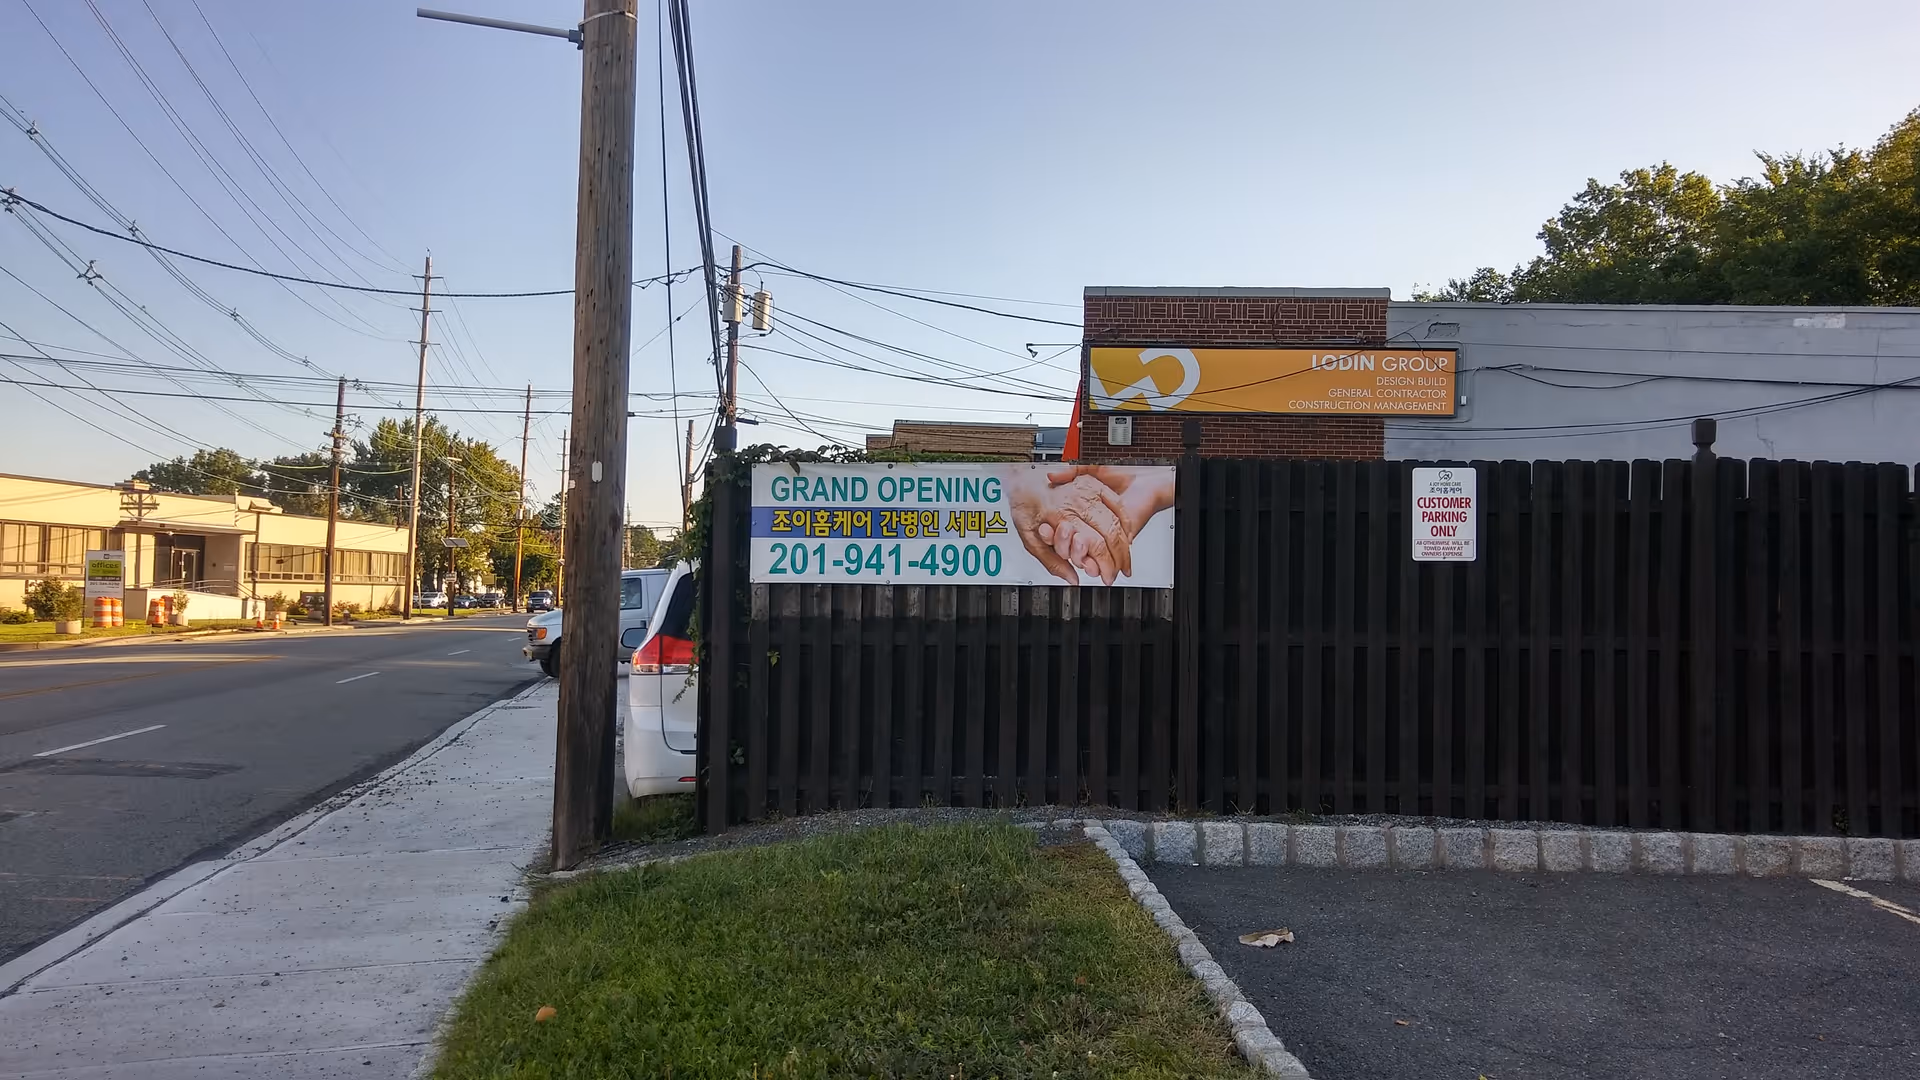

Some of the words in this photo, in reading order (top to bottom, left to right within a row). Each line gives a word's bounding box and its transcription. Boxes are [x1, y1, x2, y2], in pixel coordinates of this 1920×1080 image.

[1311, 354, 1375, 371] LODIN
[1381, 356, 1448, 373] GROUP
[1376, 376, 1415, 386] DESIGN
[1417, 376, 1447, 387] BUILD
[1328, 388, 1373, 398] GENERAL
[1376, 389, 1448, 399] CONTRACTOR
[1288, 400, 1371, 410] CONSTRUCTION
[1373, 401, 1447, 411] MANAGEMENT
[771, 476, 869, 502] GRAND
[877, 476, 1002, 503] OPENING
[1417, 497, 1471, 509] CUSTOMER
[1422, 511, 1467, 523] PARKING
[771, 509, 873, 537] 조이홈케어
[879, 510, 940, 538] 간병인
[945, 510, 1009, 538] 서비스
[1430, 525, 1458, 537] ONLY
[768, 542, 1003, 577] 201-941-4900
